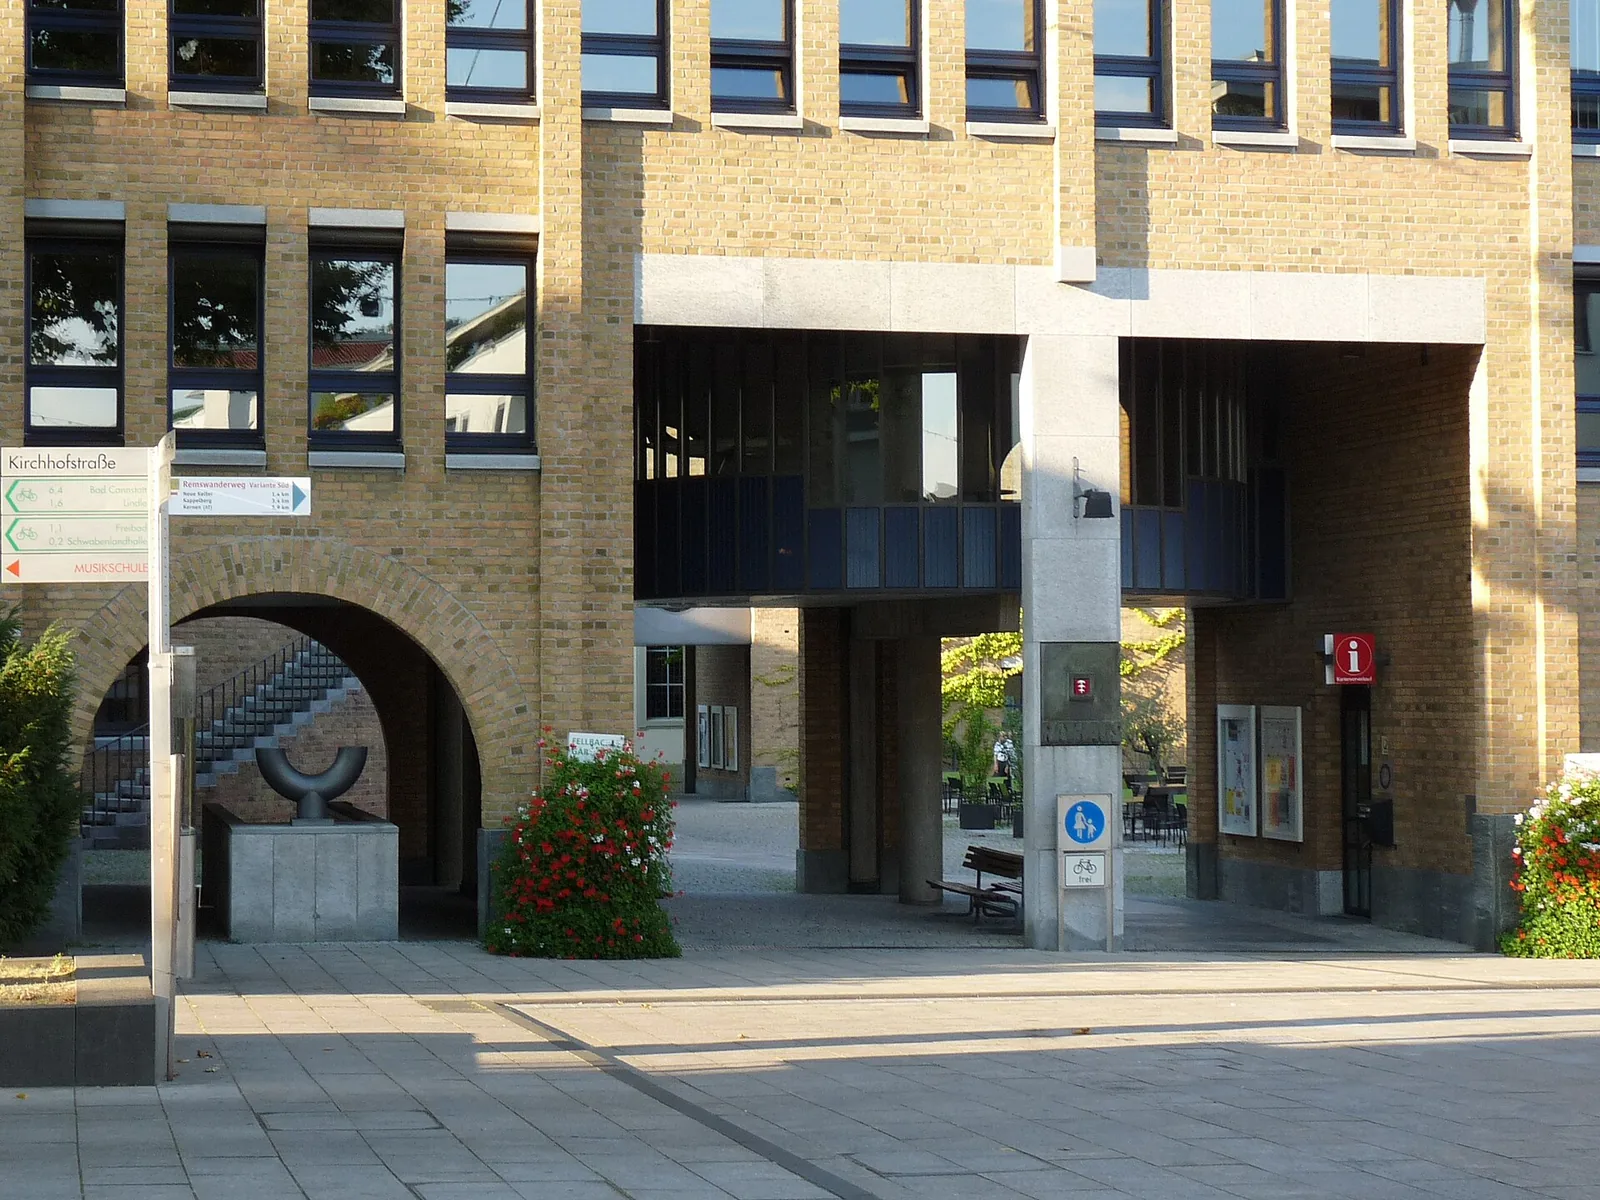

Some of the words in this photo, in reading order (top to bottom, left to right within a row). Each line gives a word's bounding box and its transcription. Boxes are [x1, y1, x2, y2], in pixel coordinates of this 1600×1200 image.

[9, 453, 117, 470] Kirchhofstraße
[89, 485, 106, 494] Bad
[182, 480, 246, 489] Remswanderweg
[249, 481, 276, 489] Variante
[277, 481, 290, 489] Süd
[49, 498, 63, 508] 1,6
[115, 522, 148, 532] Freibad
[48, 536, 63, 547] 0,2
[67, 536, 148, 546] Schwabenlandhalle
[74, 562, 149, 573] MUSIKSCHULE
[1078, 875, 1092, 883] frei
